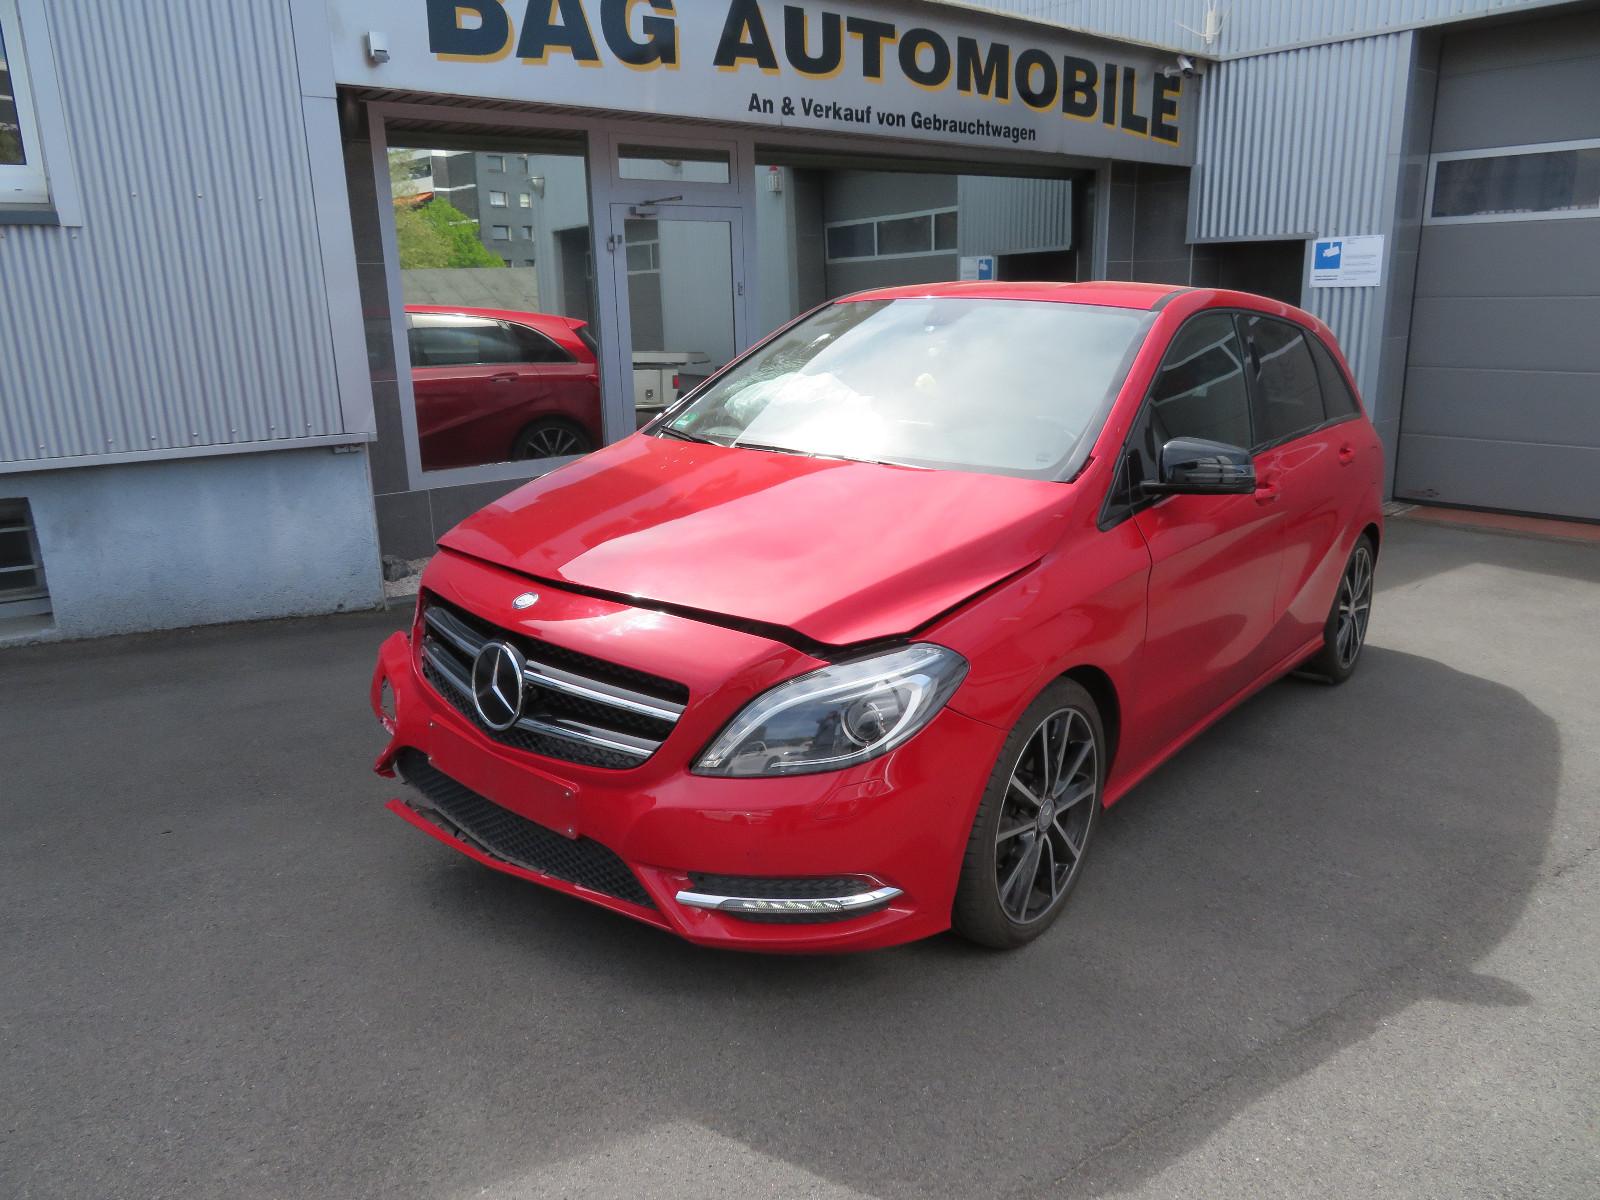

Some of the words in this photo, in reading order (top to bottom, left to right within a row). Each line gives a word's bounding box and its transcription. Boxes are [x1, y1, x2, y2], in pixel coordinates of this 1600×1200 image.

[712, 0, 1183, 148] AUTOMOBILE
[748, 93, 774, 114] An
[781, 96, 796, 116] &
[801, 97, 872, 124] Verkauf
[877, 111, 906, 128] von
[911, 111, 1037, 144] Gebrauchtwagen
